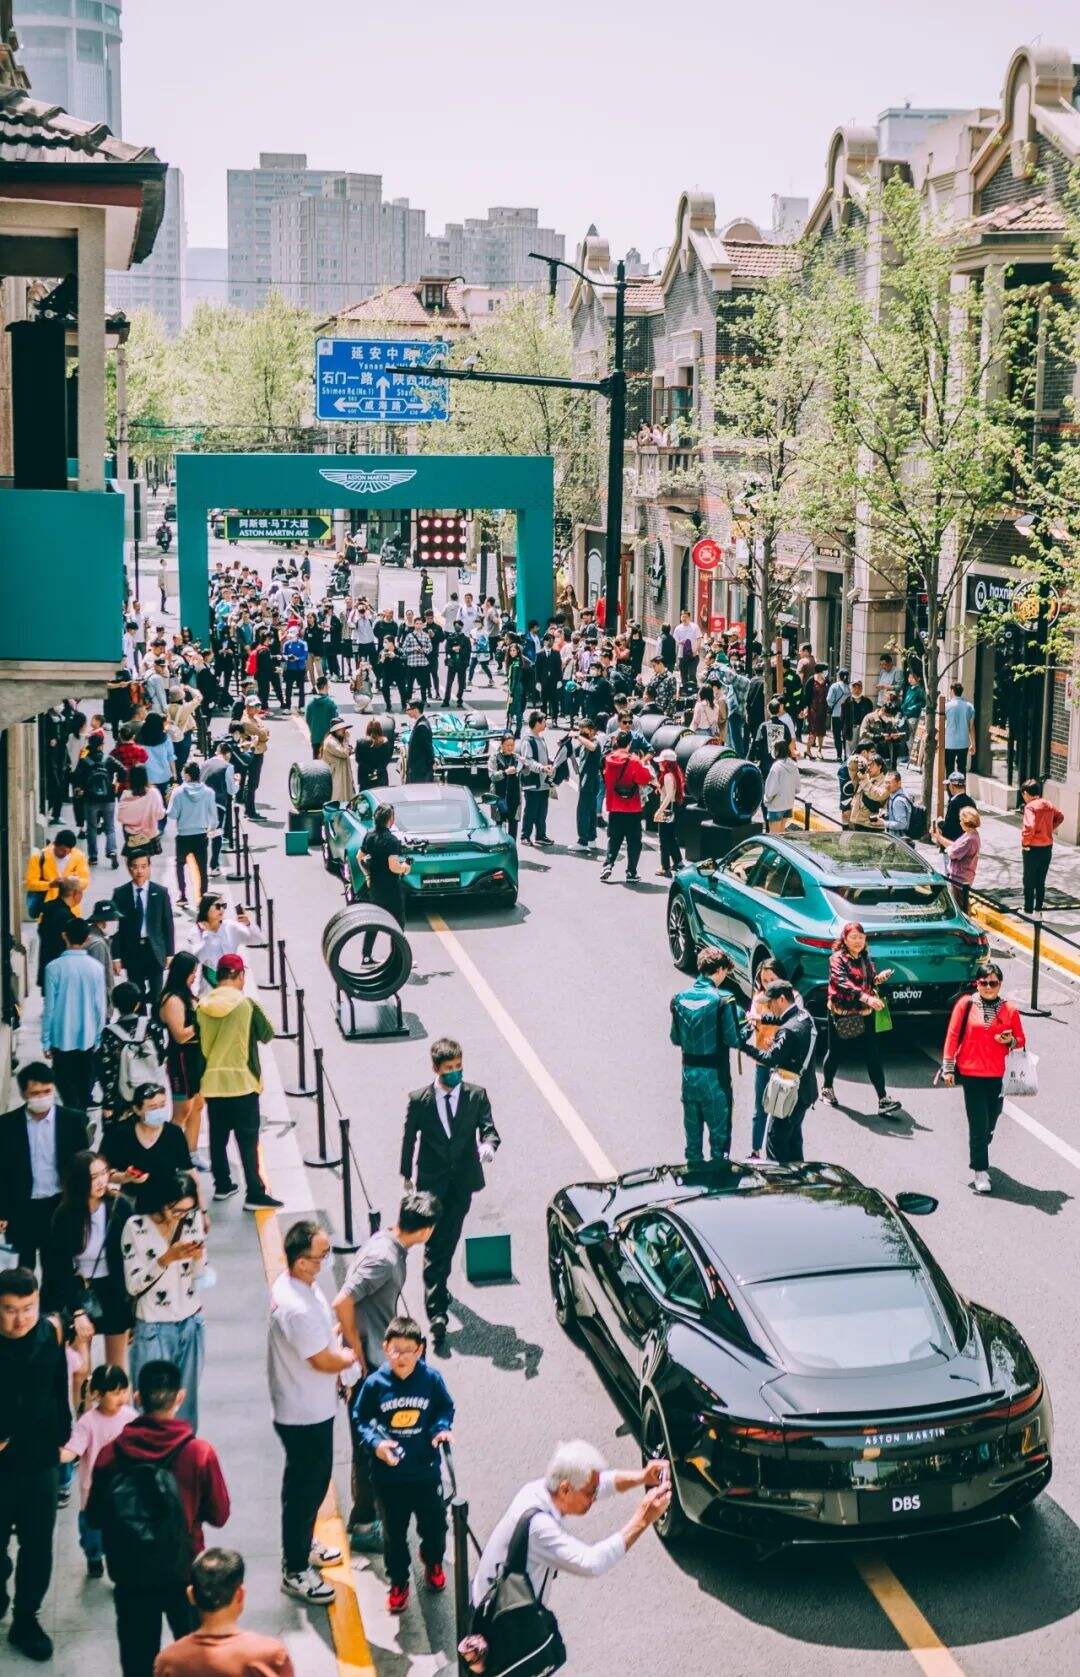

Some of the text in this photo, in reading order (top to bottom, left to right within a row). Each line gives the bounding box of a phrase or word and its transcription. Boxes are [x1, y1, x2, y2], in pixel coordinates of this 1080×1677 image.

[322, 371, 373, 386] 石门一路
[239, 529, 309, 537] ASTON MARTIN AVE
[893, 990, 922, 999] DBX707
[380, 1397, 430, 1412] SKECHERS
[865, 1428, 945, 1445] ASTON MARTIN
[892, 1495, 921, 1512] DBS
